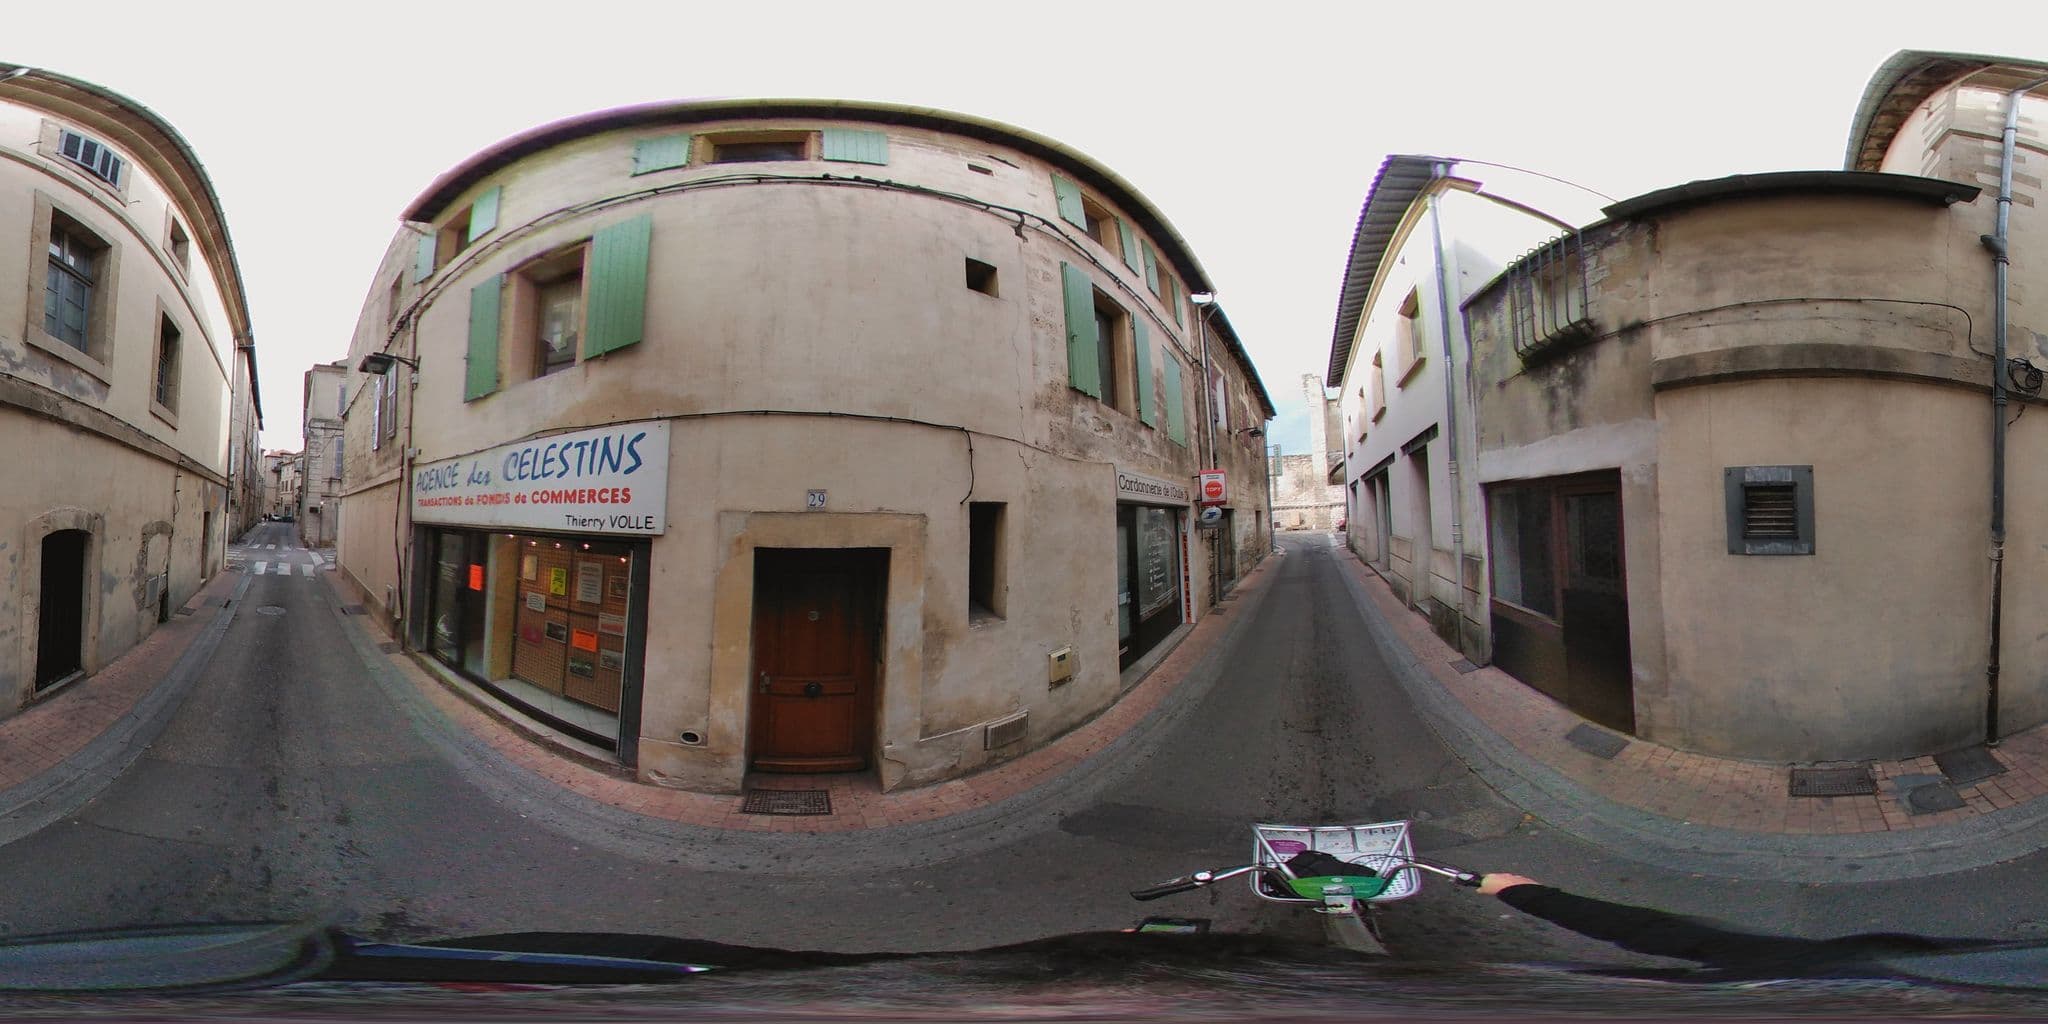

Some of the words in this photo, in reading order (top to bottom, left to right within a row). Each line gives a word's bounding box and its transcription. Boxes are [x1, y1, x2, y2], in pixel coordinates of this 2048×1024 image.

[416, 462, 460, 493] AGENCE
[466, 460, 491, 487] des
[502, 432, 647, 482] CELESTINS
[1118, 474, 1163, 496] Cordonnerie
[1163, 484, 1170, 497] de
[418, 495, 463, 508] TRANSACTIONS
[464, 496, 474, 506] de
[514, 491, 527, 504] de
[531, 487, 632, 505] COMMERCES
[809, 493, 825, 507] 29
[565, 514, 606, 530] Thierry
[609, 515, 656, 530] VOLLE
